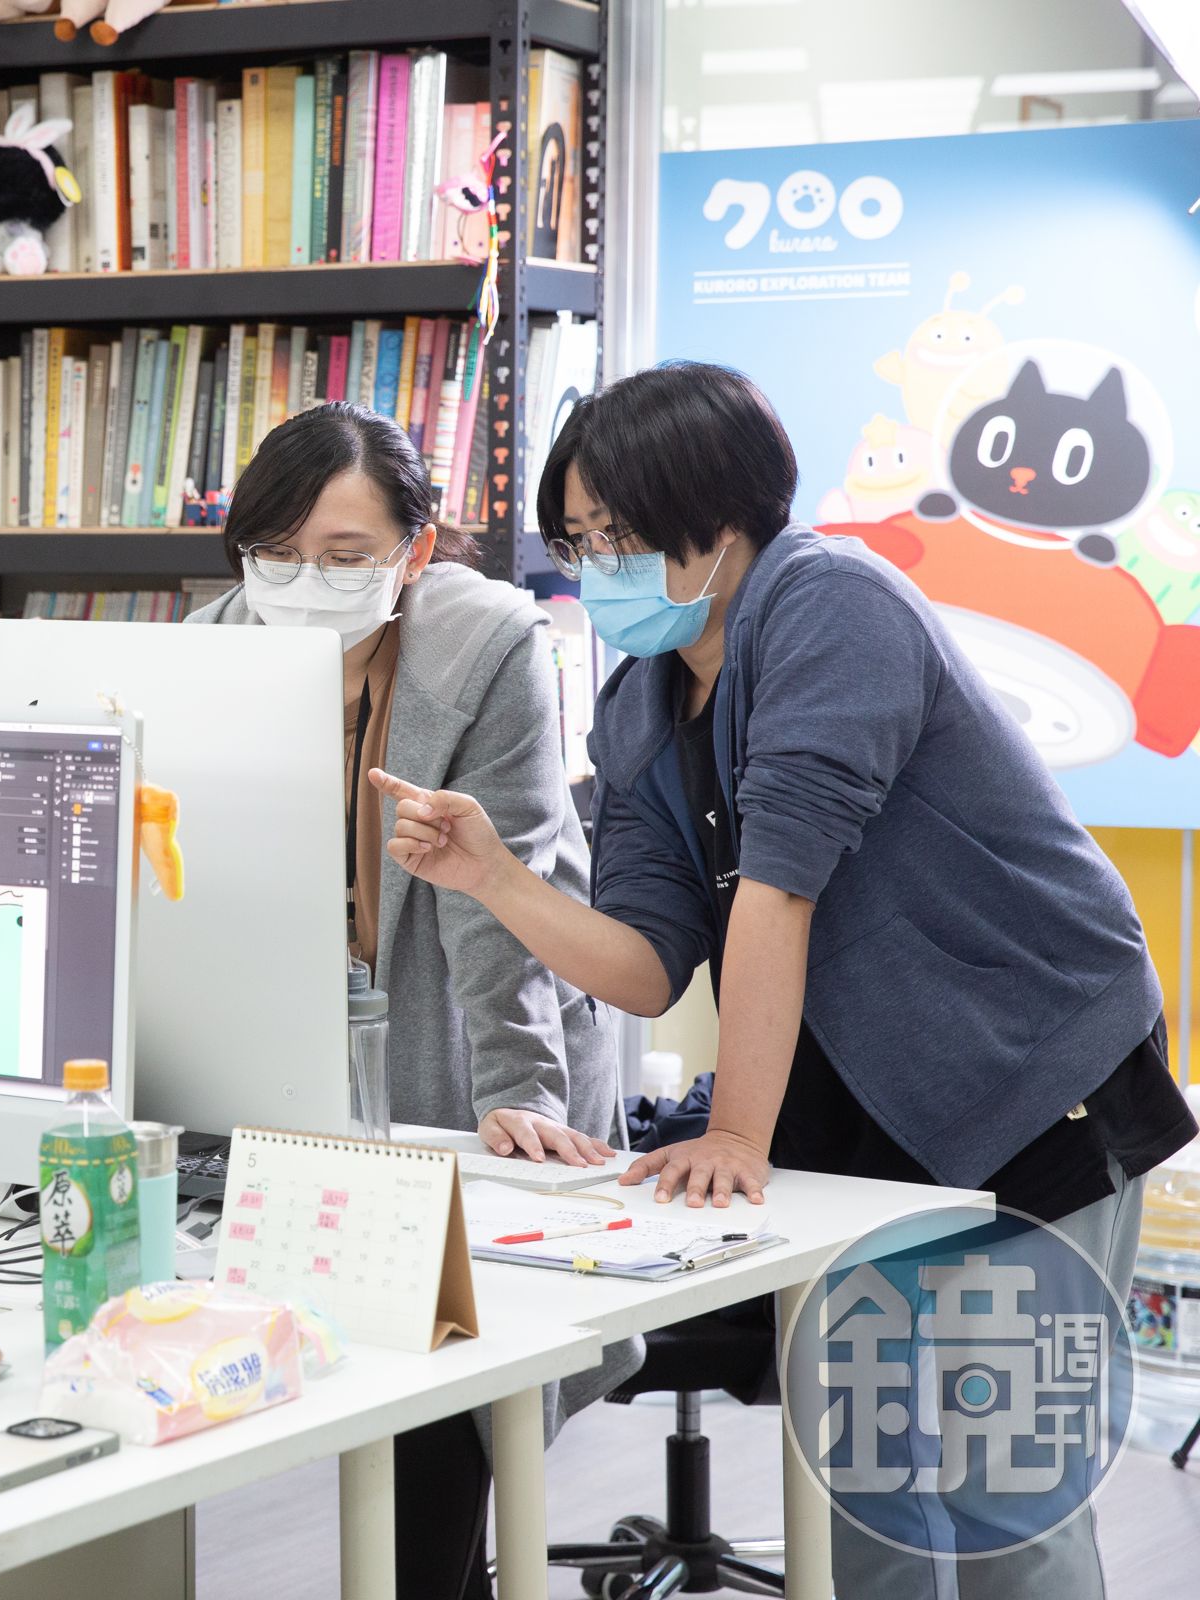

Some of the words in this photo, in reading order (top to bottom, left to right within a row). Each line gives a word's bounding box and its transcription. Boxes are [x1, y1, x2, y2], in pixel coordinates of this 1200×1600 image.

[693, 277, 759, 294] KURORO
[760, 273, 865, 293] EXPLORATION
[867, 271, 912, 288] TEAM
[247, 1152, 257, 1168] 5
[45, 1170, 76, 1257] 原萃
